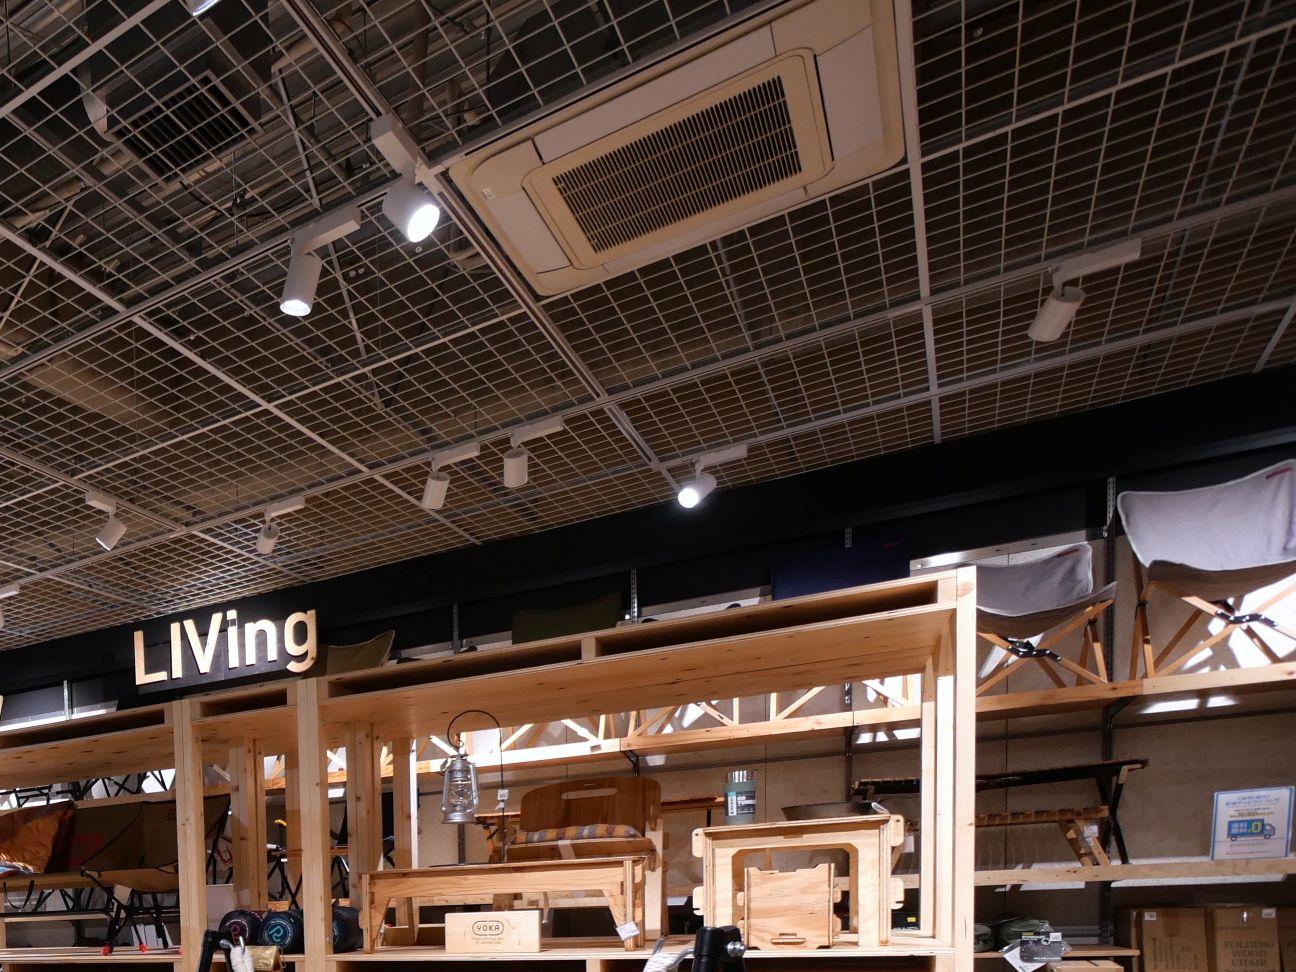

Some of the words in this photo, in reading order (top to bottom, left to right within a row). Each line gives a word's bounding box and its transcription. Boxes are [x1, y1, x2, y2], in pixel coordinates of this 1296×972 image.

[134, 609, 317, 685] LIVing
[1224, 941, 1274, 949] FOLDING
[1232, 959, 1267, 967] CHAIR
